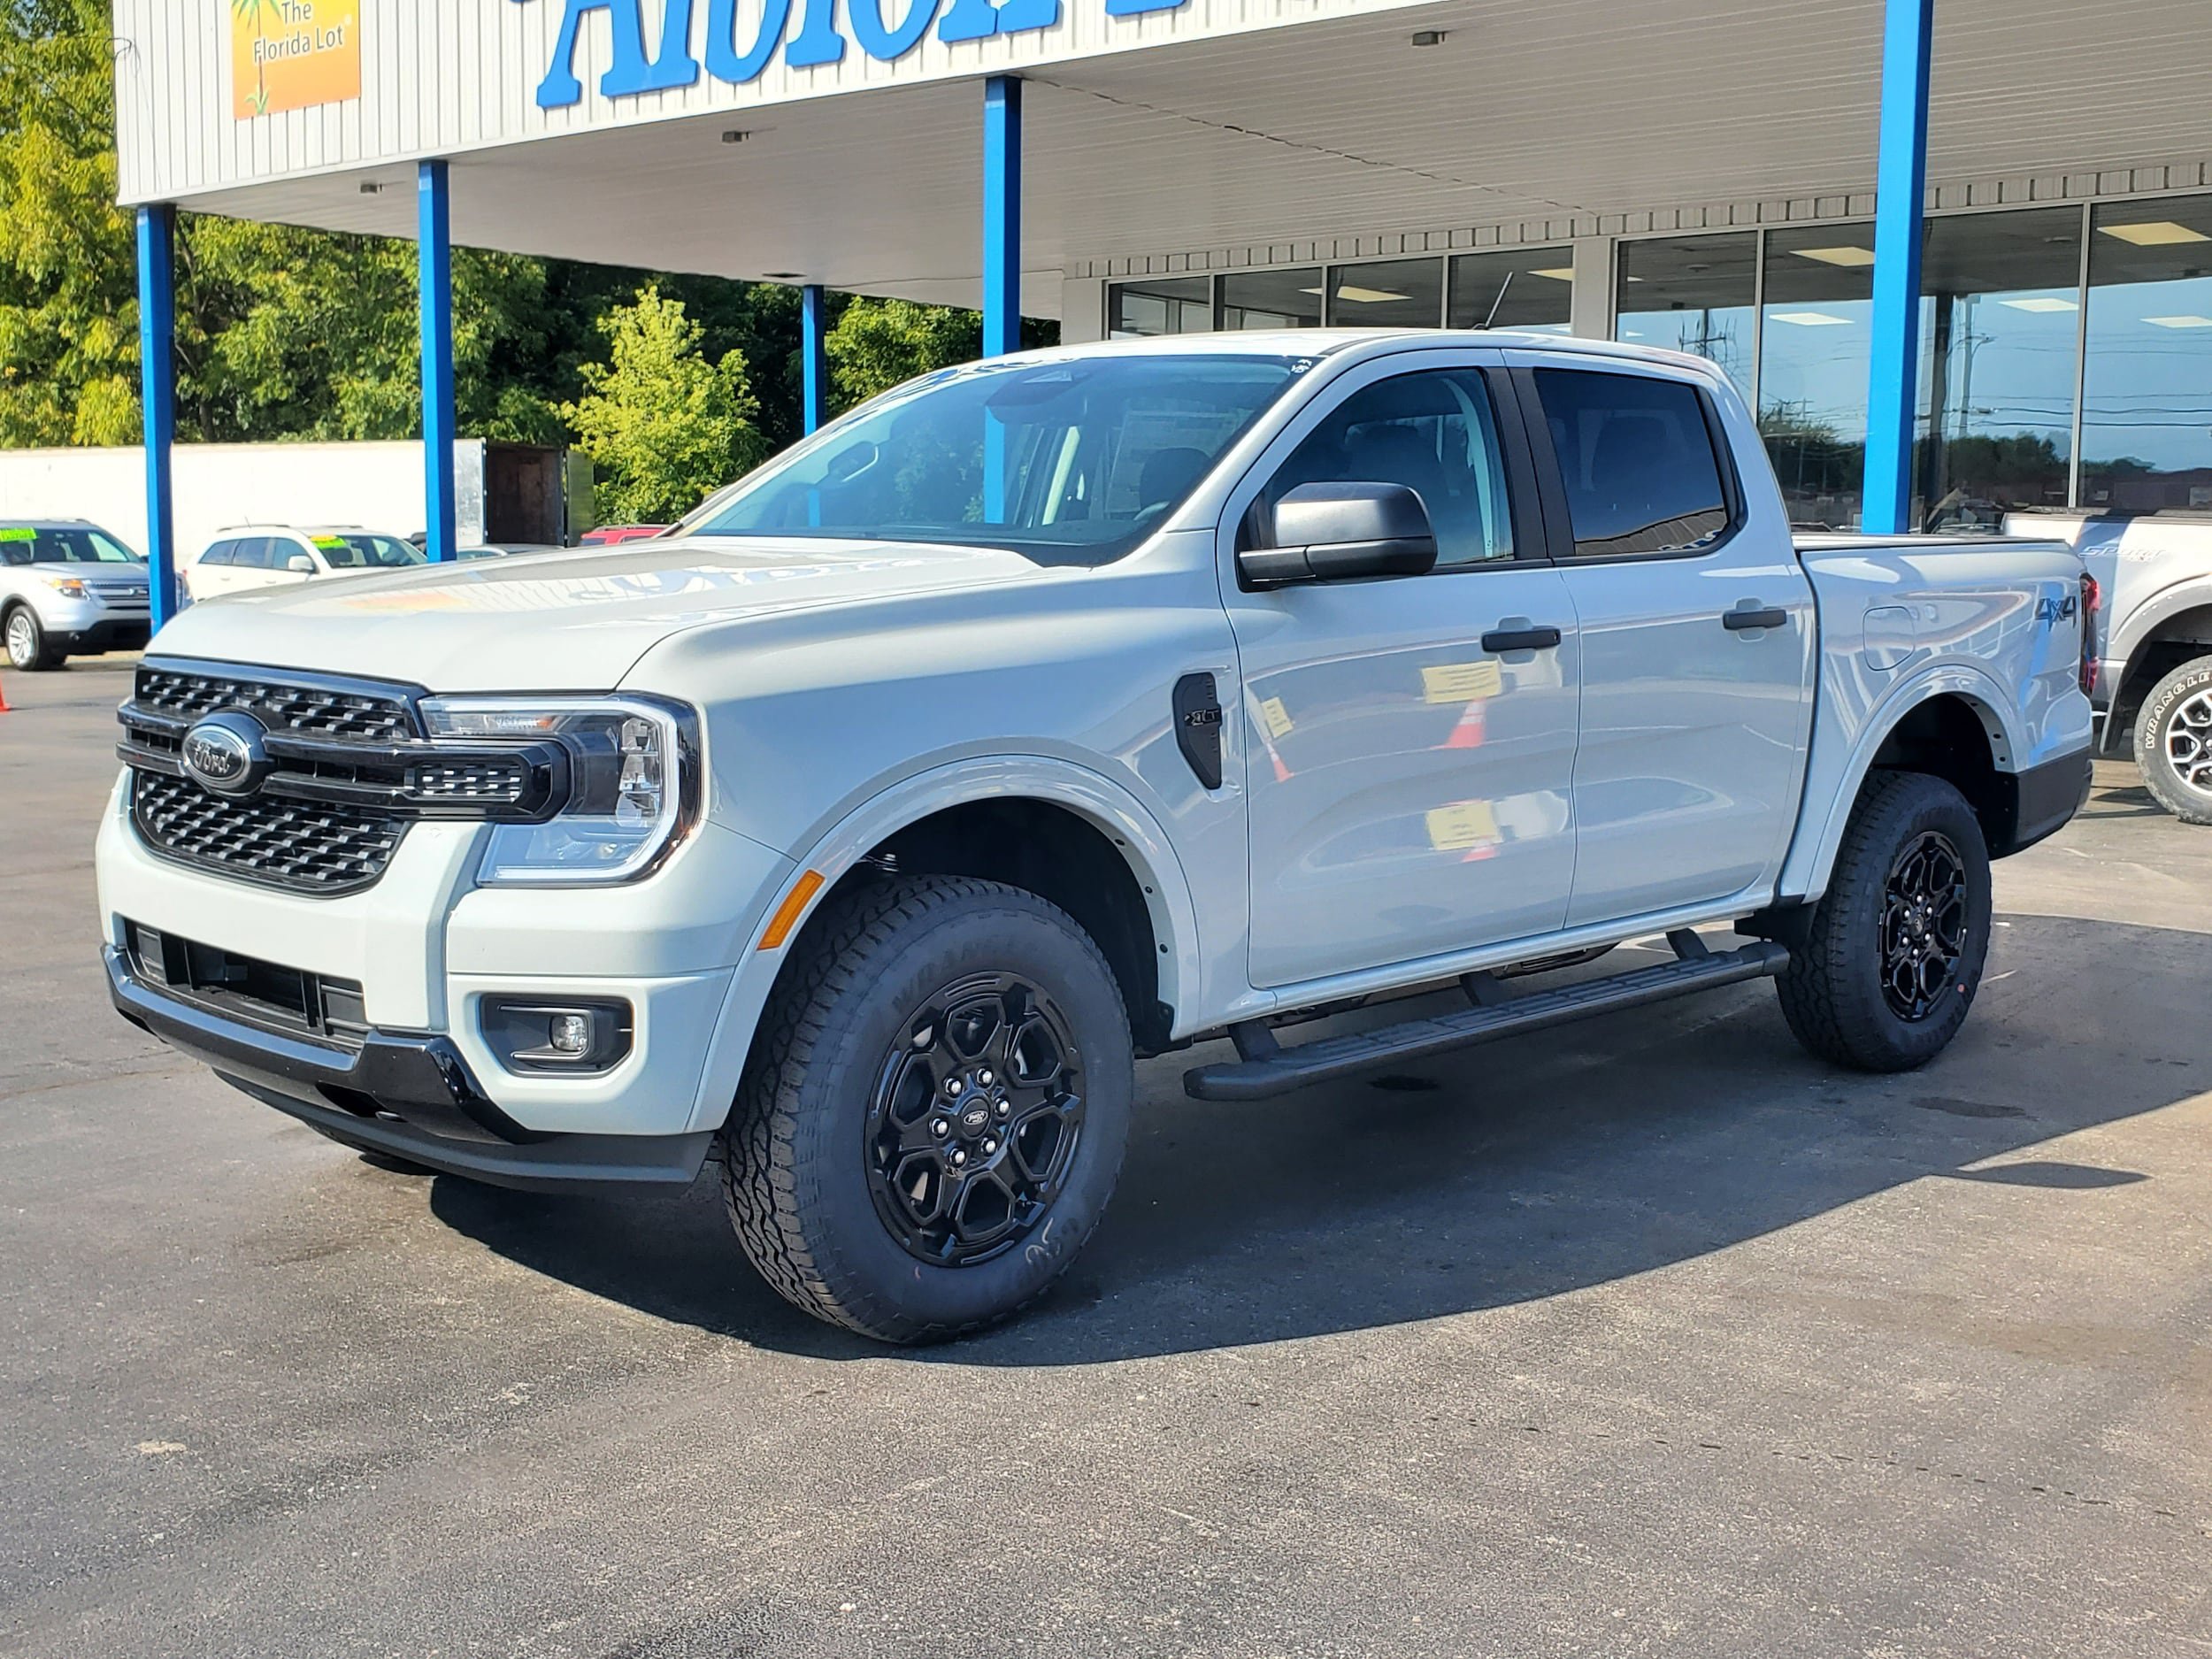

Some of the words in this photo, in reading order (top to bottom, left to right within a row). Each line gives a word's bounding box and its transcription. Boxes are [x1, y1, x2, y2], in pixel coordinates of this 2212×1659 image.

[281, 0, 311, 24] The
[254, 30, 311, 63] Florida
[316, 26, 343, 50] Lot
[2035, 595, 2078, 632] 4x4
[2145, 671, 2212, 750] WRANGLE
[194, 739, 231, 774] Ford
